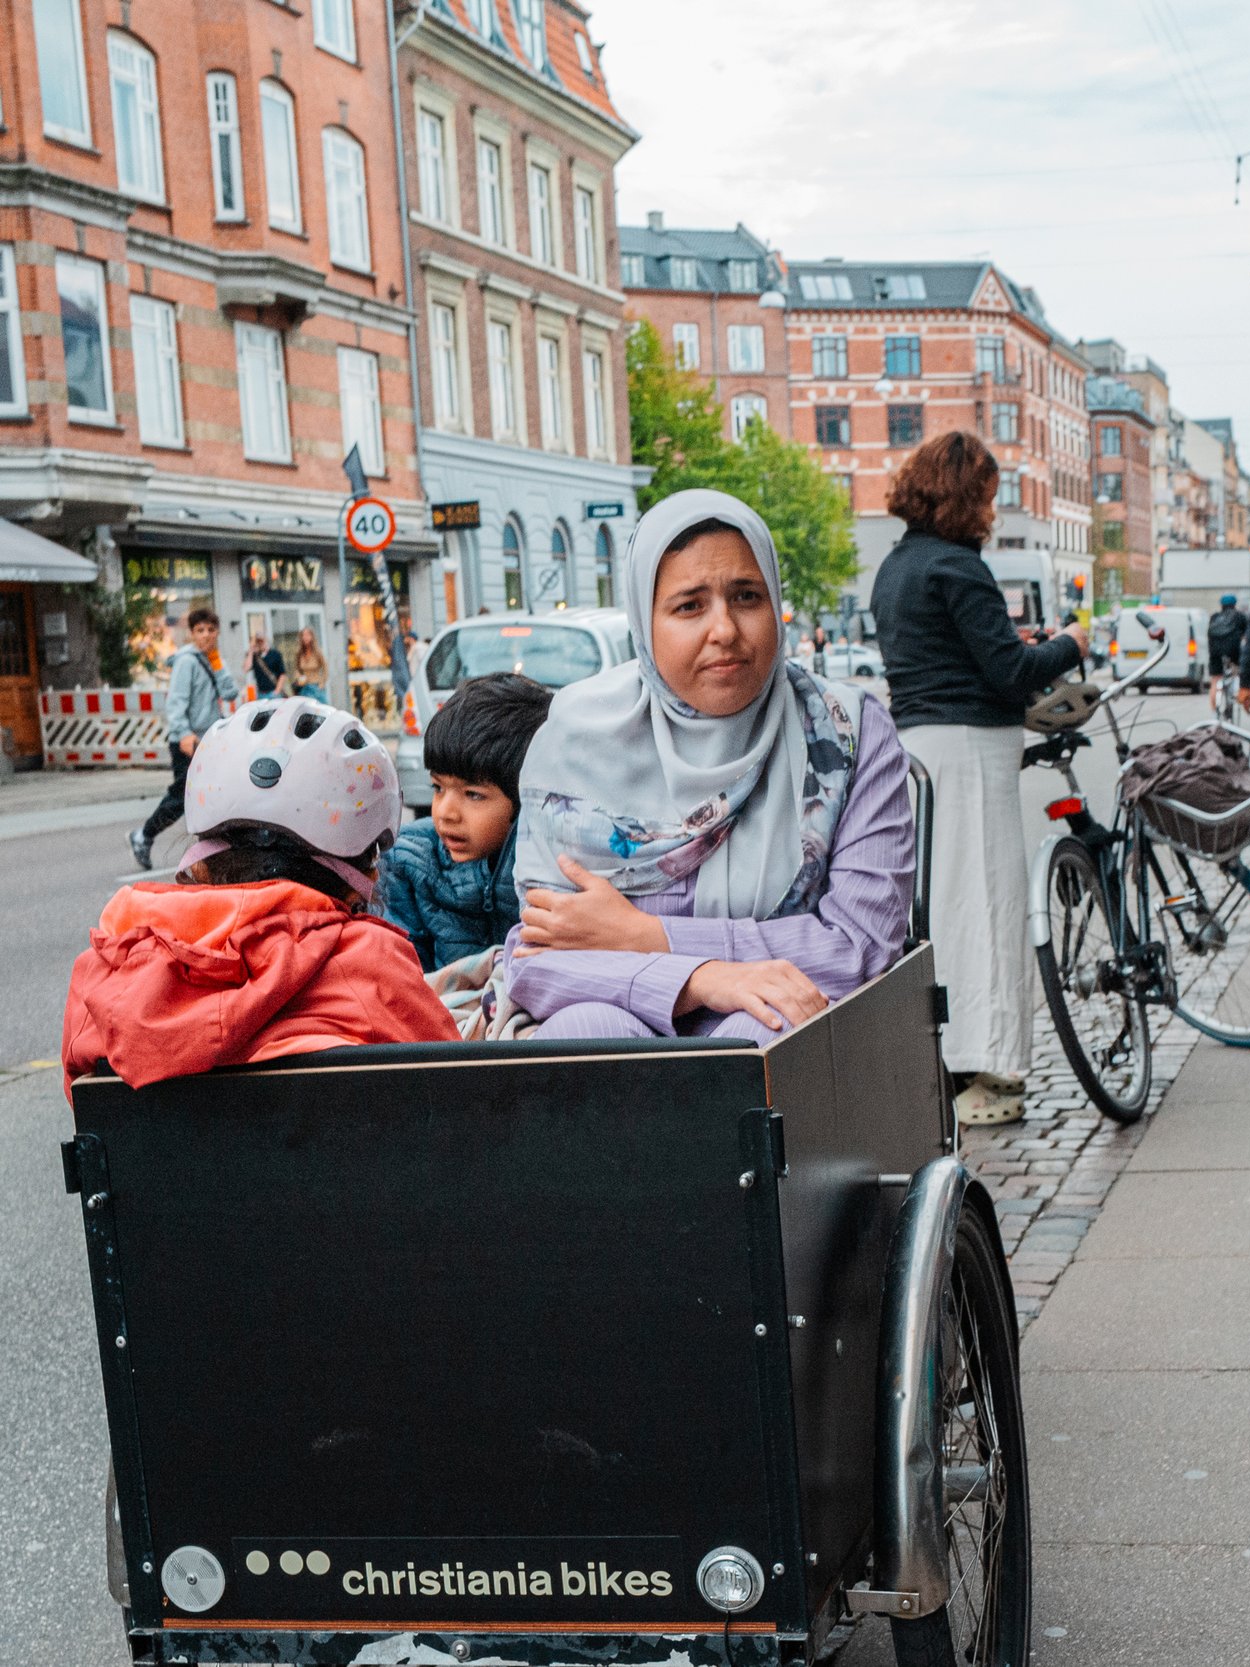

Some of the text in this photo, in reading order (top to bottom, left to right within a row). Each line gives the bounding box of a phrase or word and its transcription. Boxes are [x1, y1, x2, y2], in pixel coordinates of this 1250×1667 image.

[355, 514, 386, 535] 40
[342, 1562, 673, 1596] christiania bikes
